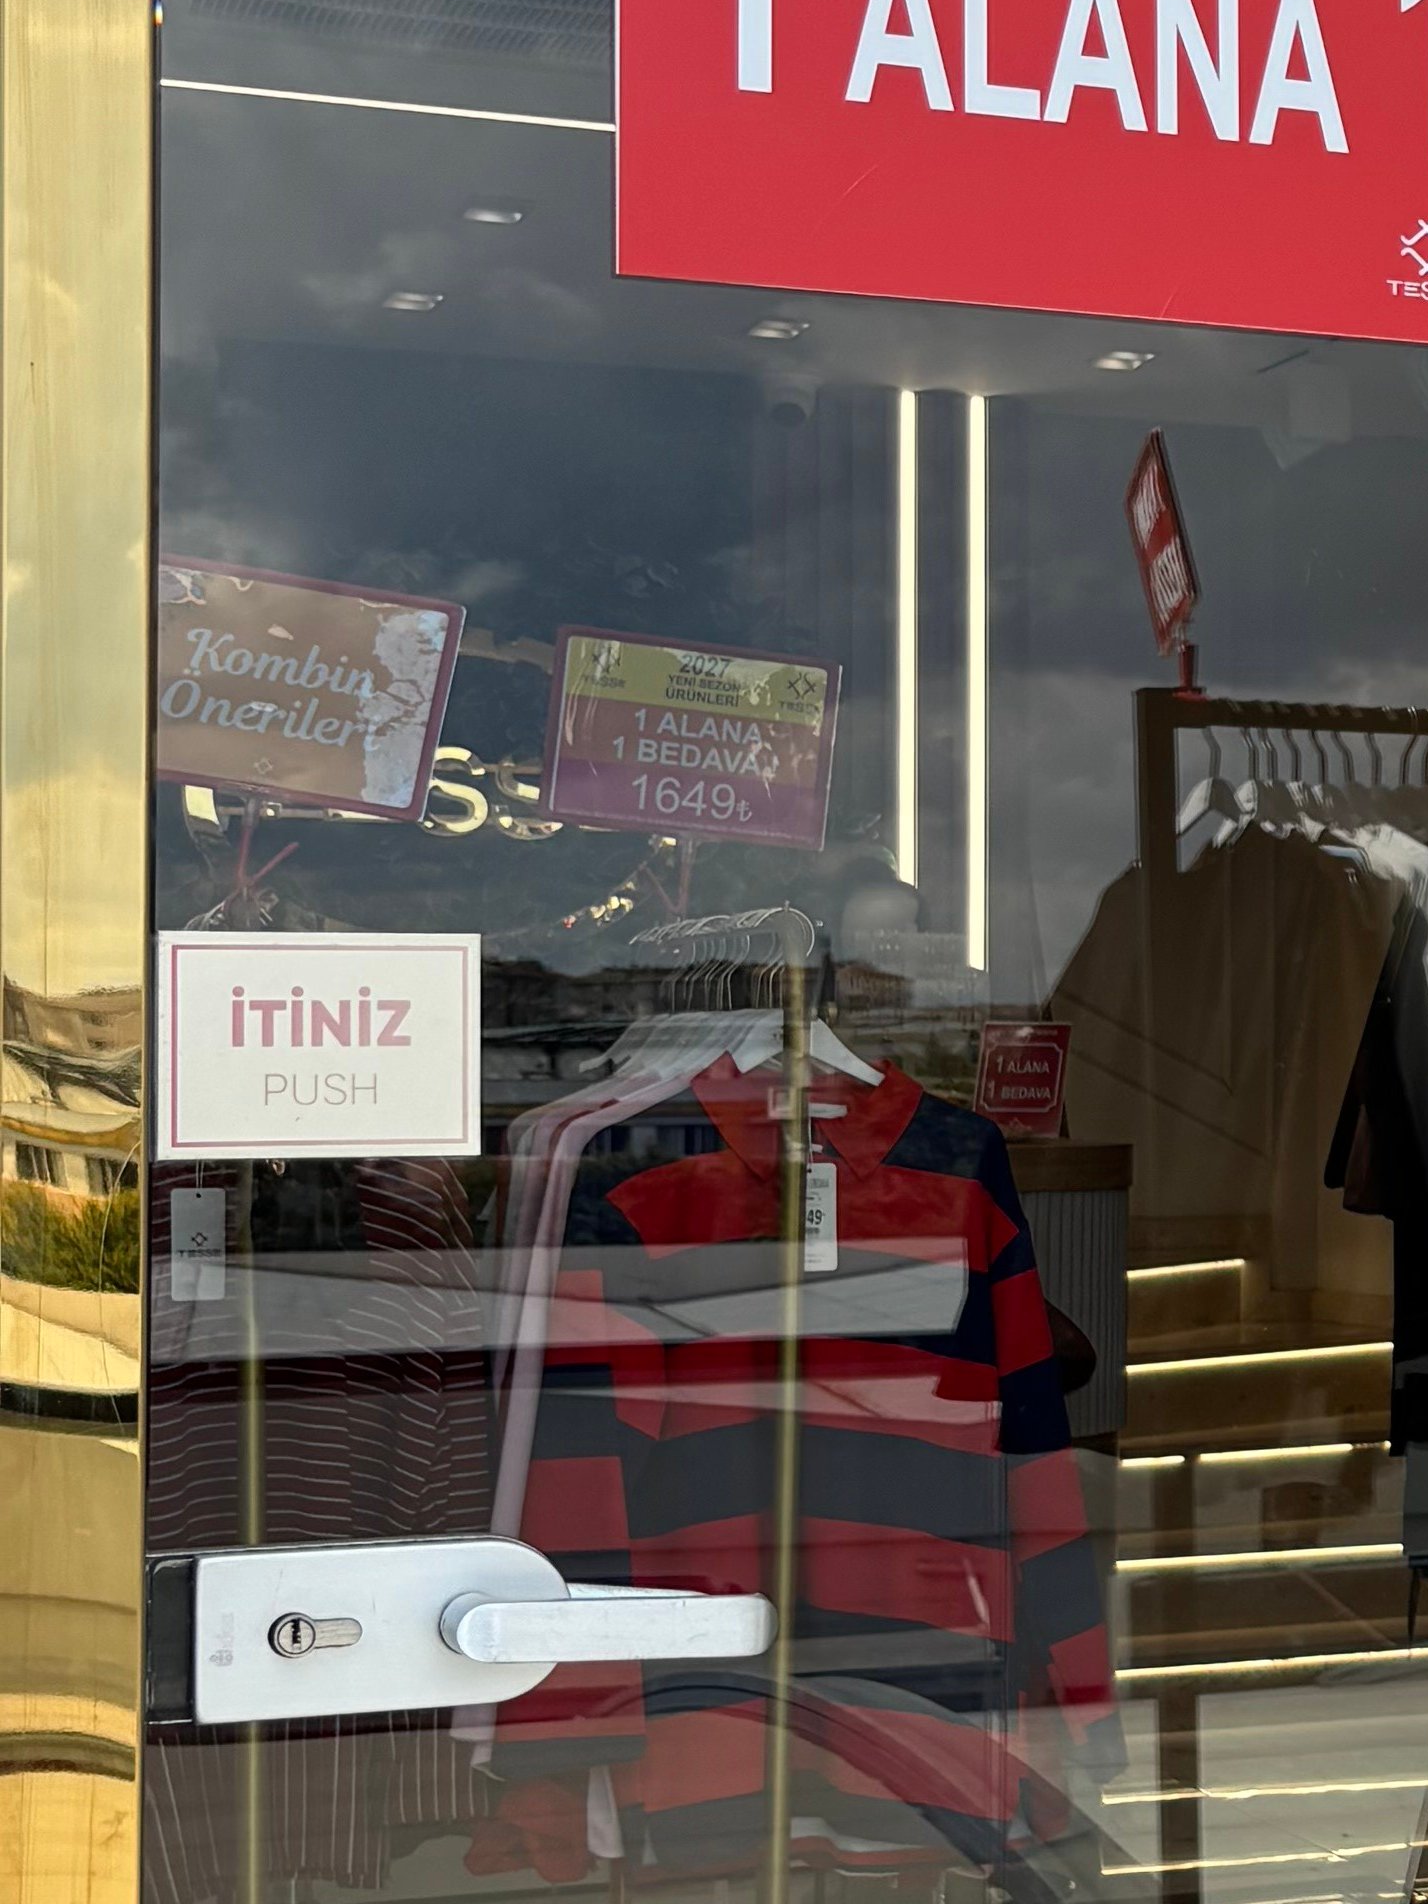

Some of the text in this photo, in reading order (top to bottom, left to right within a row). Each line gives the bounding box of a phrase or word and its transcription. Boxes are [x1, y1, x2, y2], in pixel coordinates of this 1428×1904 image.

[186, 627, 378, 700] Kombin
[160, 667, 379, 752] Önerileri
[634, 708, 763, 745] 1 ALANA
[612, 736, 761, 775] 1 BEDAVA
[231, 985, 412, 1047] İTİNİZ
[1006, 1059, 1051, 1074] ALANA
[264, 1072, 378, 1106] PUSH
[1000, 1085, 1052, 1101] BEDAVA
